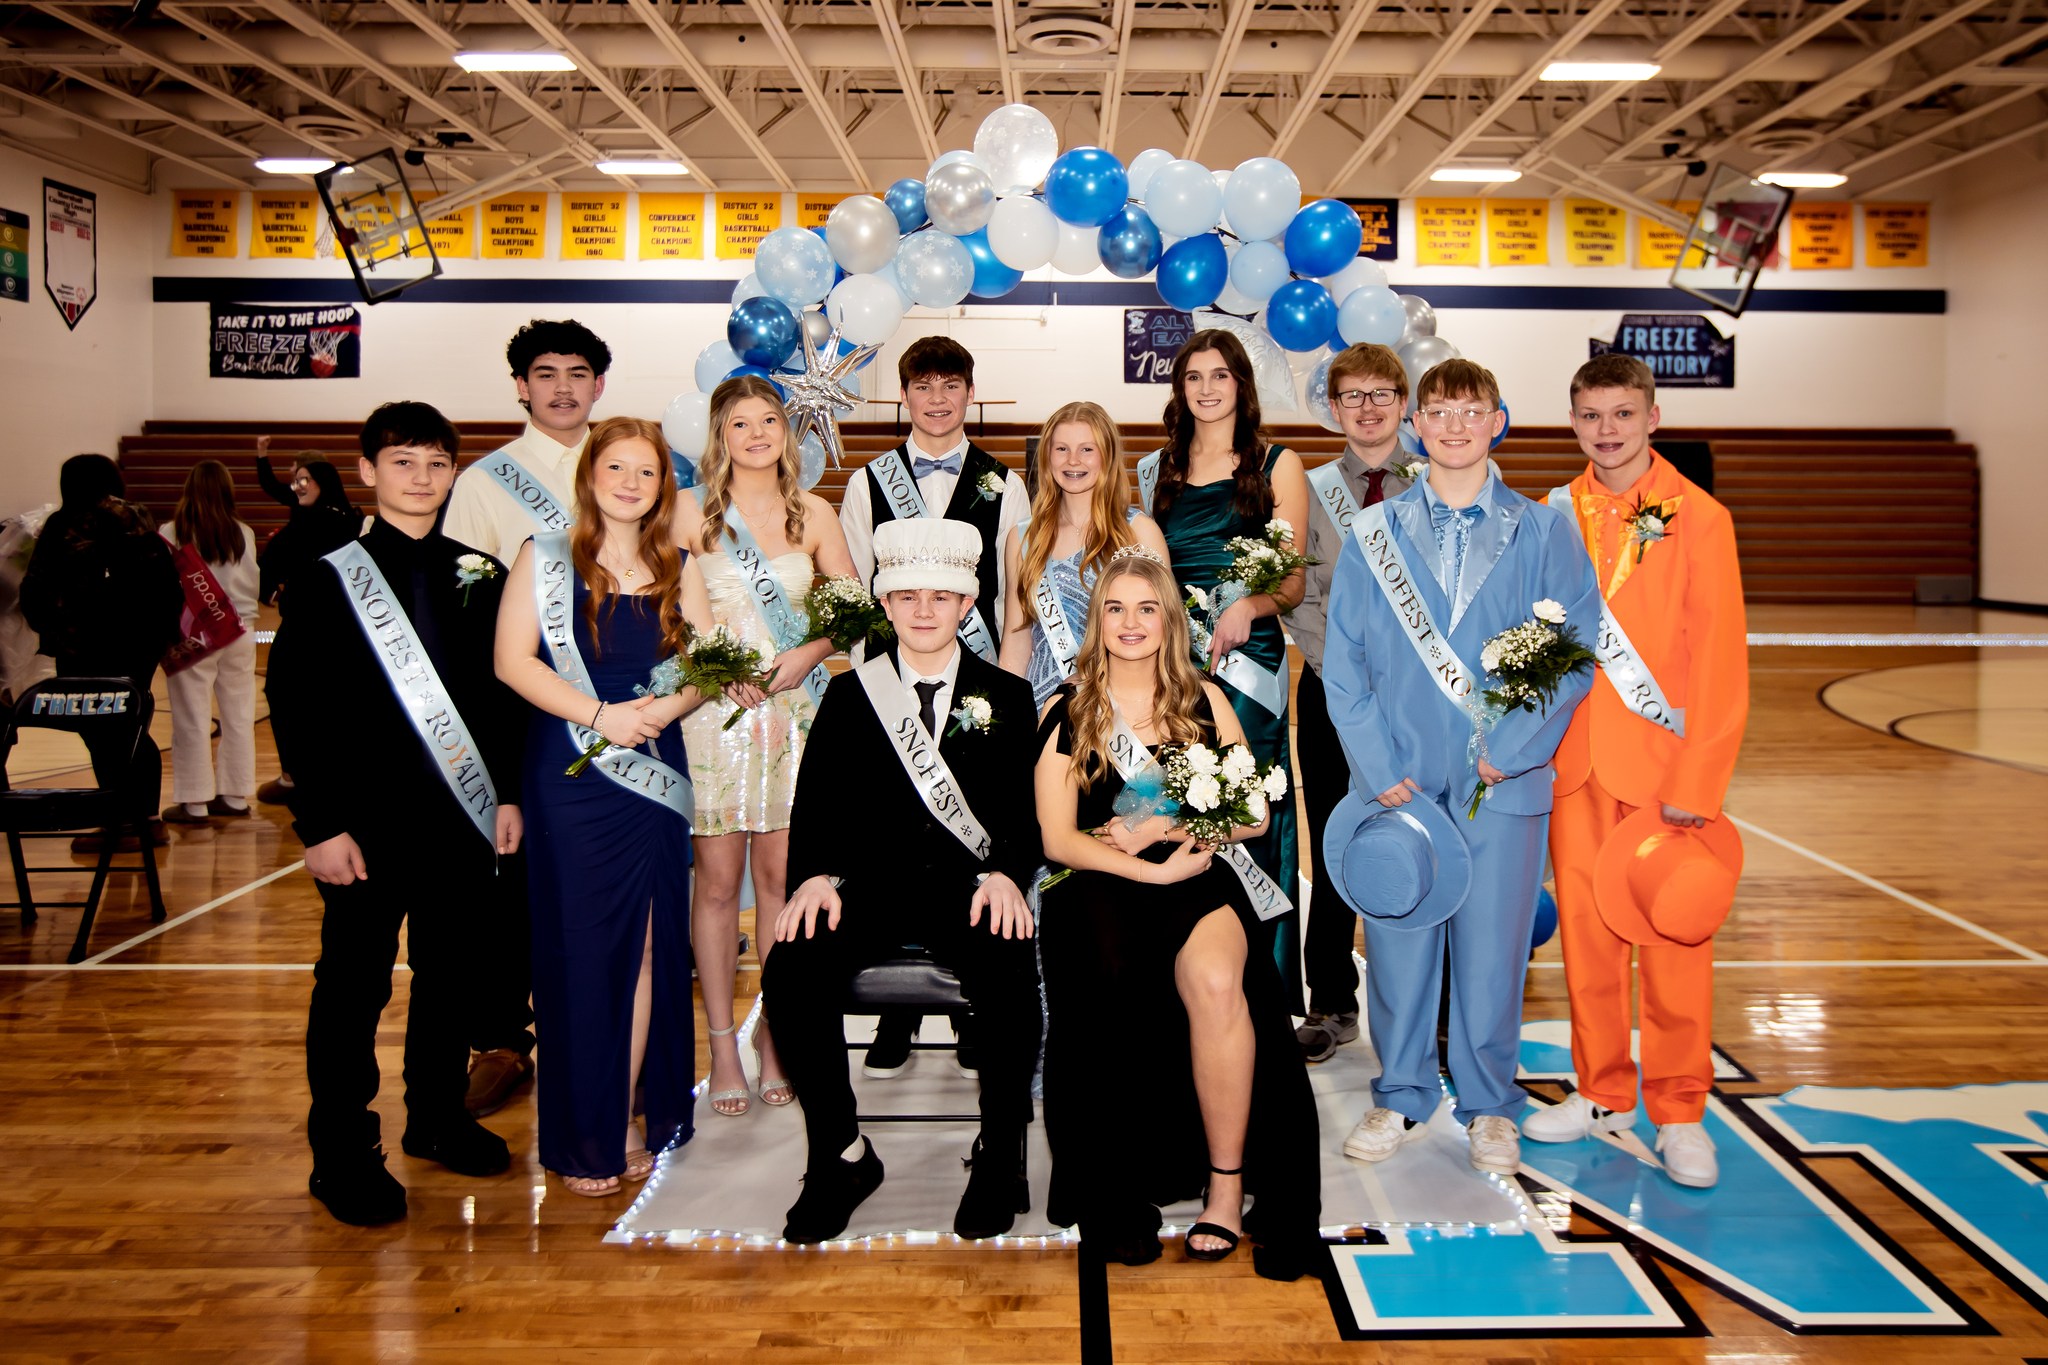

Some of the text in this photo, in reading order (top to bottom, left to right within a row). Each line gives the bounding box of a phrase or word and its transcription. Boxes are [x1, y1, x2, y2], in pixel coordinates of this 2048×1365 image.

[181, 201, 214, 209] DISTRICT
[261, 201, 296, 209] DISTRICT
[490, 204, 525, 212] DISTRICT
[723, 202, 774, 210] DISTRICT 32
[275, 212, 295, 220] BOYS
[1493, 208, 1527, 216] DISTRICT
[584, 214, 606, 222] GIRLS
[737, 213, 759, 221] GIRLS
[184, 224, 229, 232] BASKETBALL
[263, 224, 308, 232] BASKETBALL
[186, 235, 225, 243] CHAMPIONS
[265, 235, 305, 243] CHAMPIONS
[1495, 231, 1538, 239] VOLLEYBALL
[492, 239, 534, 247] CHAMPIONS
[575, 237, 616, 245] CHAMPIONS
[651, 237, 693, 245] CHAMPIONS
[726, 236, 764, 244] CHAMPIO
[218, 307, 354, 329] TAKE IT TO THE HOOP
[215, 331, 307, 353] FREEZE
[1623, 327, 1698, 351] FREEZE
[222, 354, 300, 375] Basketball
[1634, 355, 1711, 375] RITORY
[877, 456, 923, 519] SNOF
[494, 463, 571, 530] SNOFE
[1365, 529, 1435, 643] SNOFEST
[187, 569, 226, 621] jcp.com
[347, 566, 494, 817] SNOFEST ROYALTY
[32, 691, 130, 715] FREEZE
[896, 717, 964, 824] SNOFEST
[1224, 843, 1281, 912] UEEN
